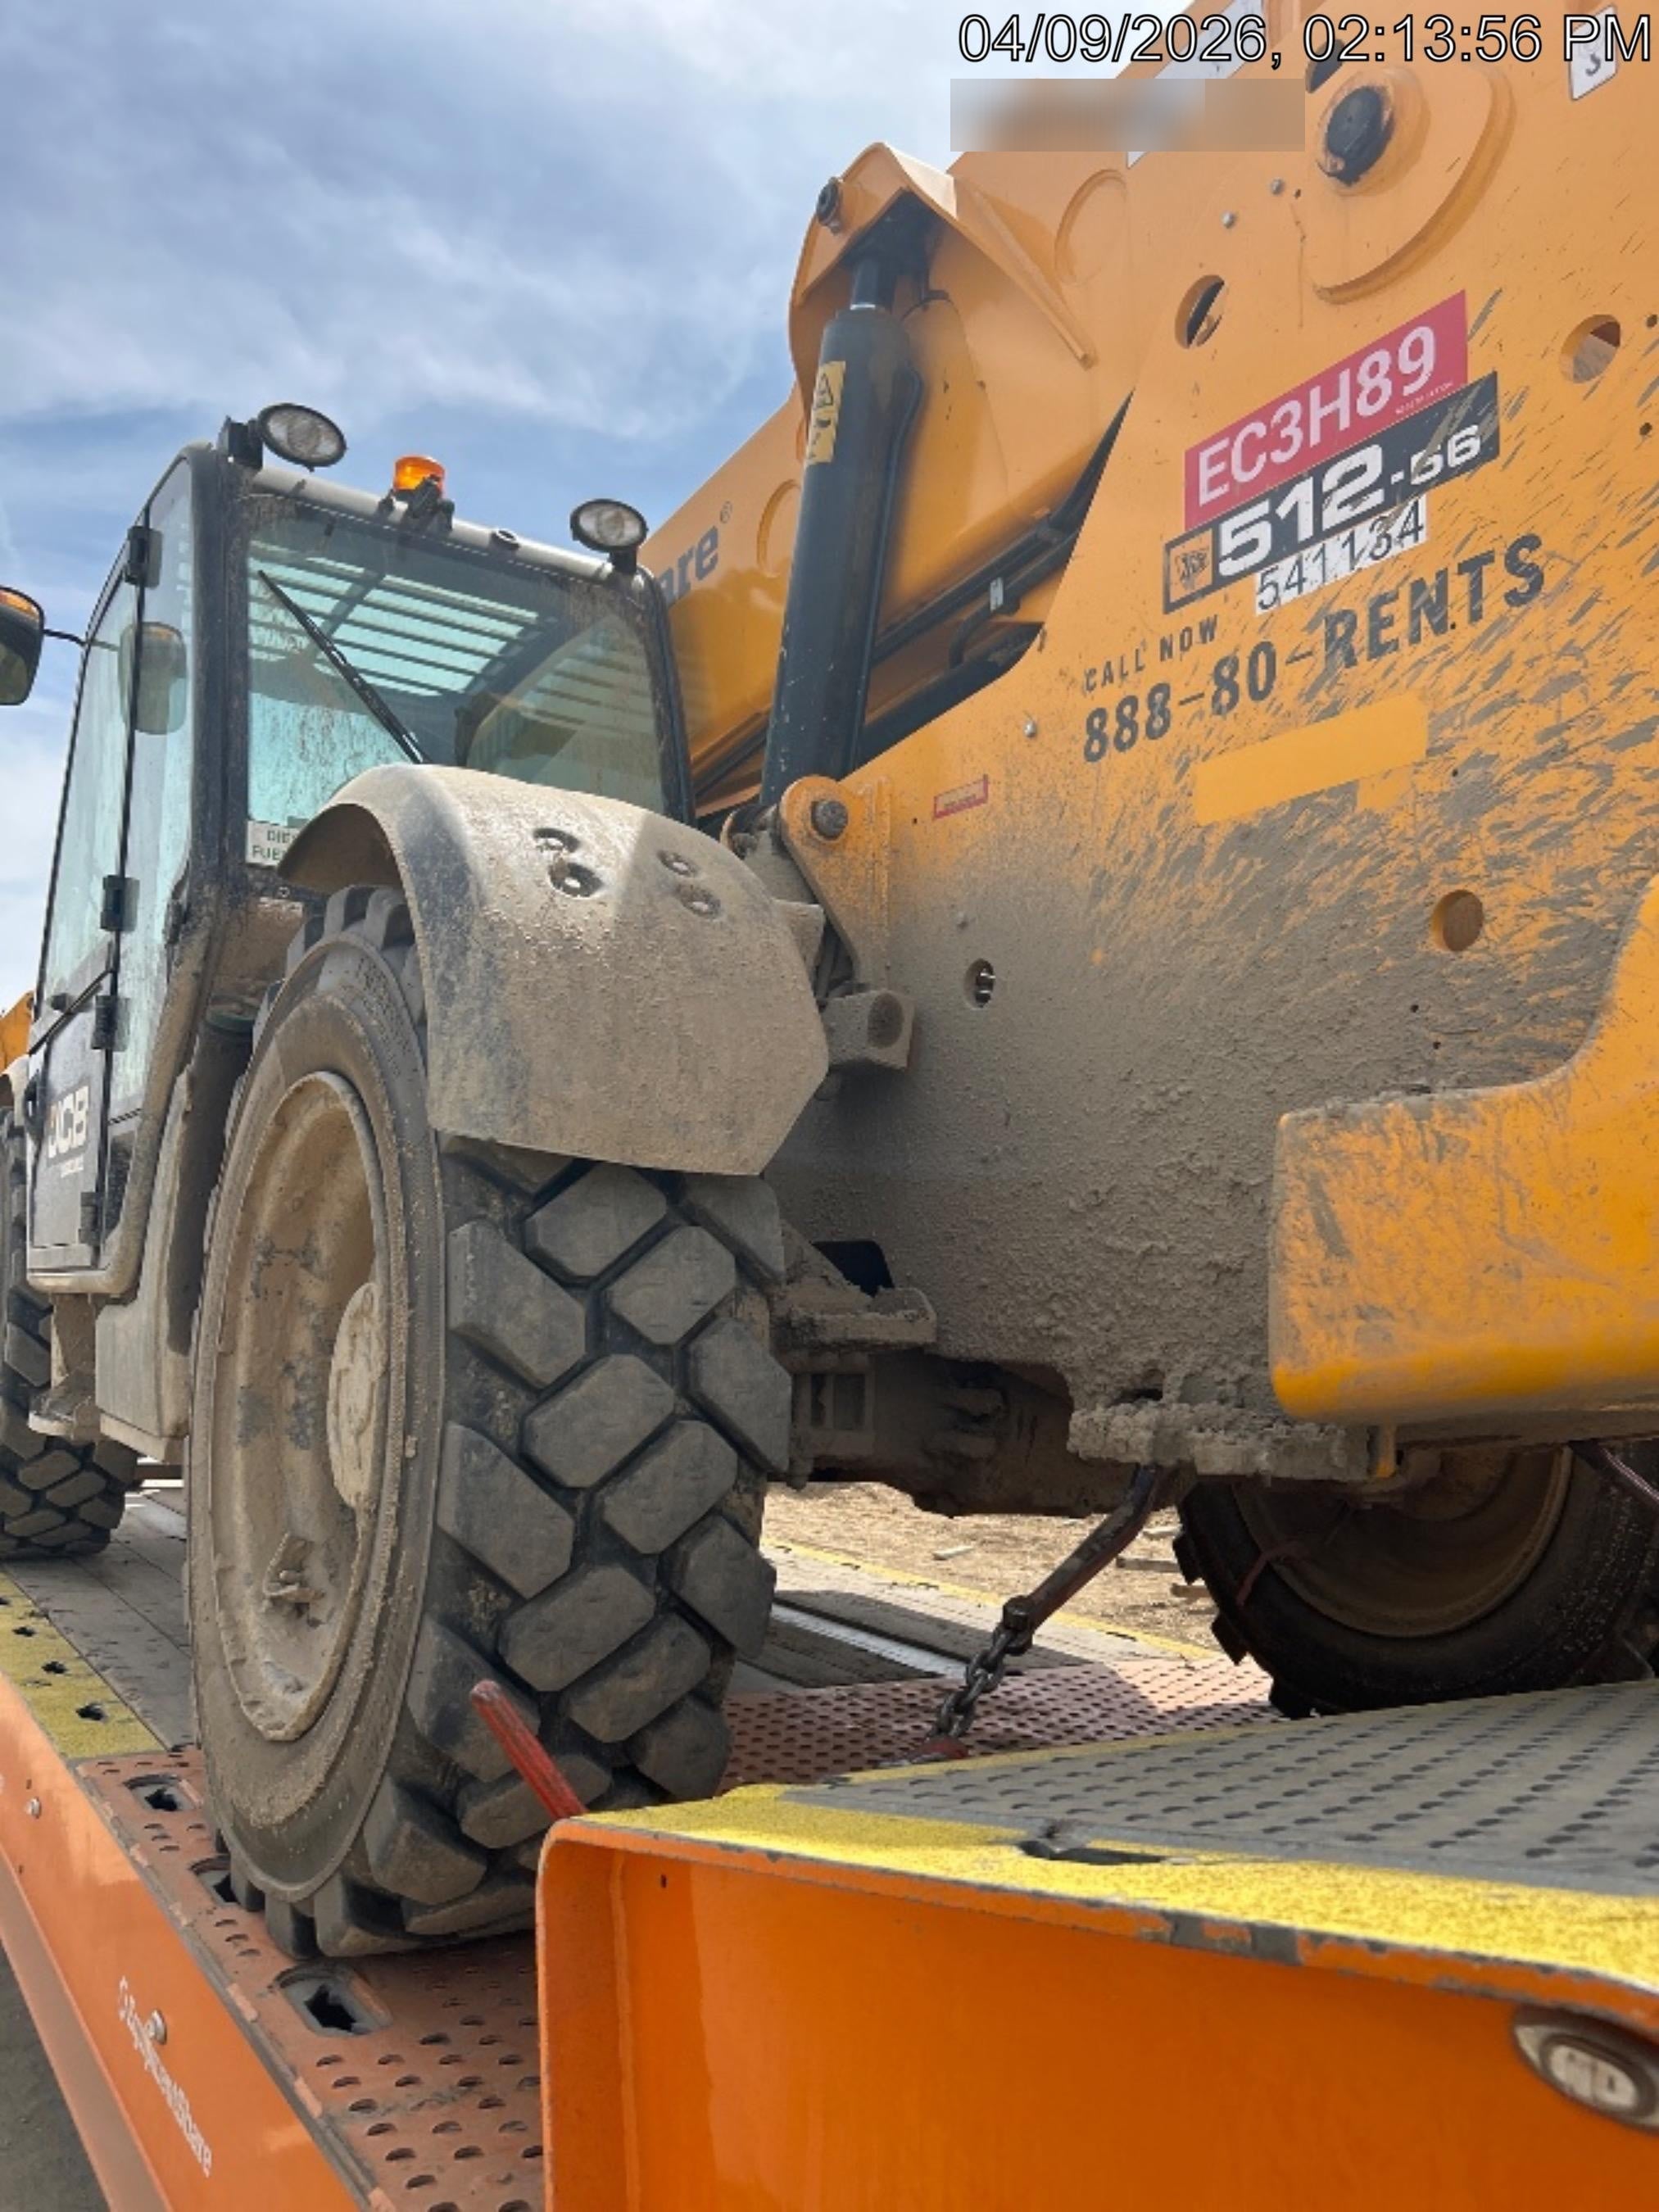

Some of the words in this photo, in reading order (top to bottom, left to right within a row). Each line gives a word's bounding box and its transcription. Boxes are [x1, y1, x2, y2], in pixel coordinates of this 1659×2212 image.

[1198, 325, 1437, 507] EC3H89
[1258, 493, 1425, 610] 541134
[1083, 533, 1546, 763] 888-80-RENTS
[1085, 648, 1146, 692] CALL
[1159, 614, 1218, 662] NOW
[48, 1086, 89, 1158] JCB
